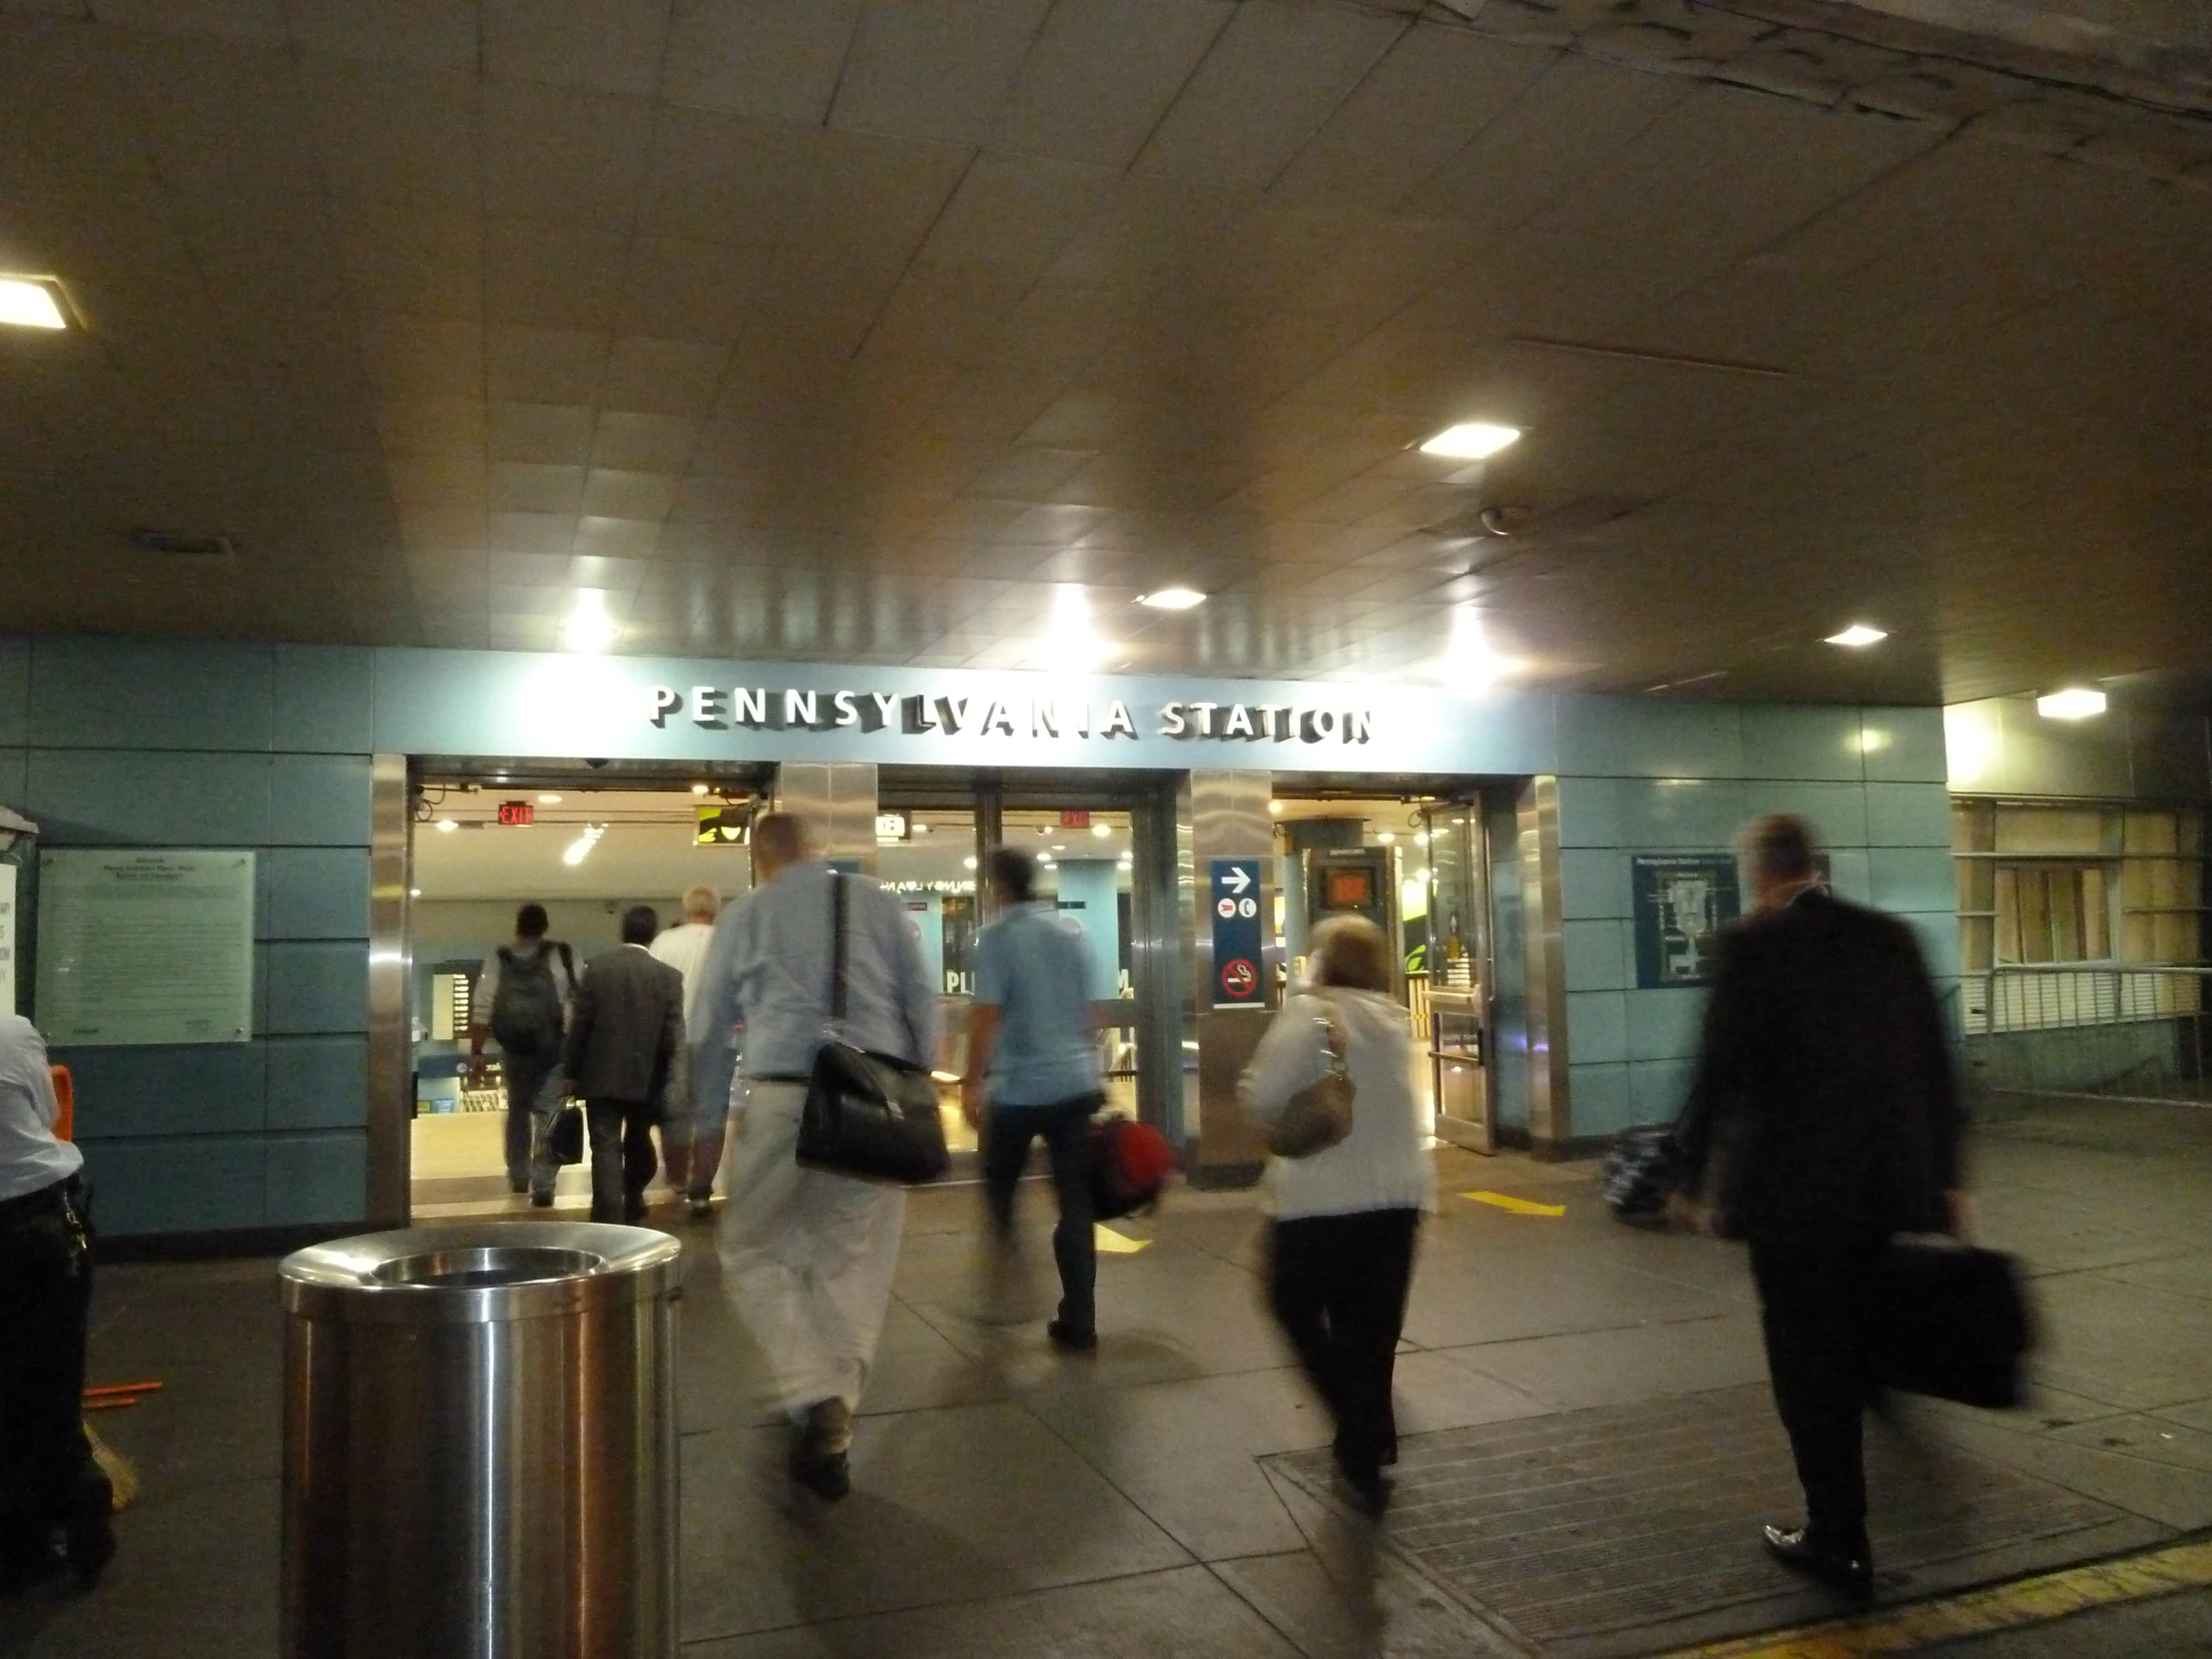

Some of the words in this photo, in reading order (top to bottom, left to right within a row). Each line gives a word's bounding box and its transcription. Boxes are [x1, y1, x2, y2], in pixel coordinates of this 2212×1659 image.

[649, 685, 1137, 738] PENNSYLVANIA
[1159, 701, 1372, 745] STATION
[501, 806, 530, 824] EXIT
